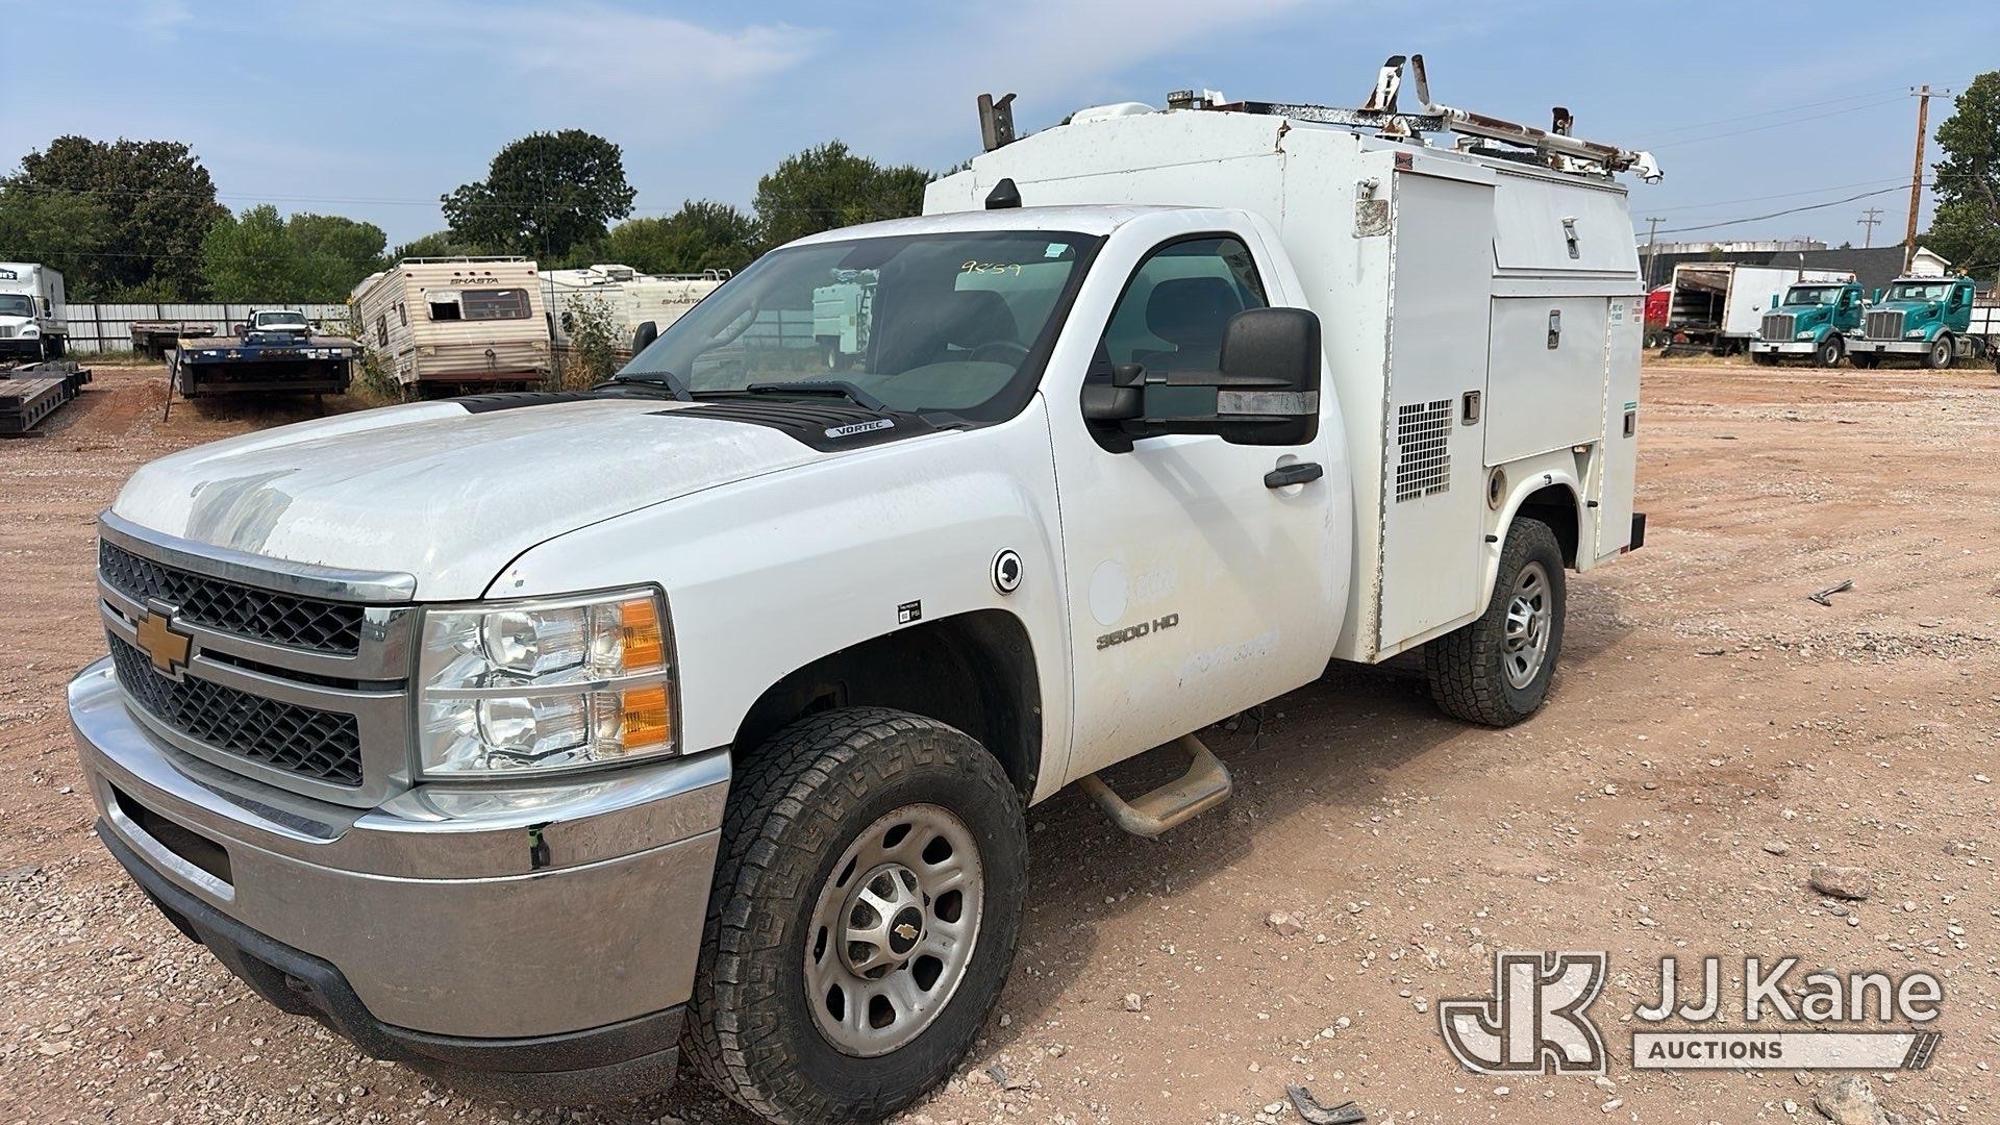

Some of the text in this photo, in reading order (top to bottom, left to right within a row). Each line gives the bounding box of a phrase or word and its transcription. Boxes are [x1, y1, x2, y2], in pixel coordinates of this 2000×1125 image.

[837, 422, 883, 434] VORTEC
[1096, 613, 1179, 650] 3500 HD
